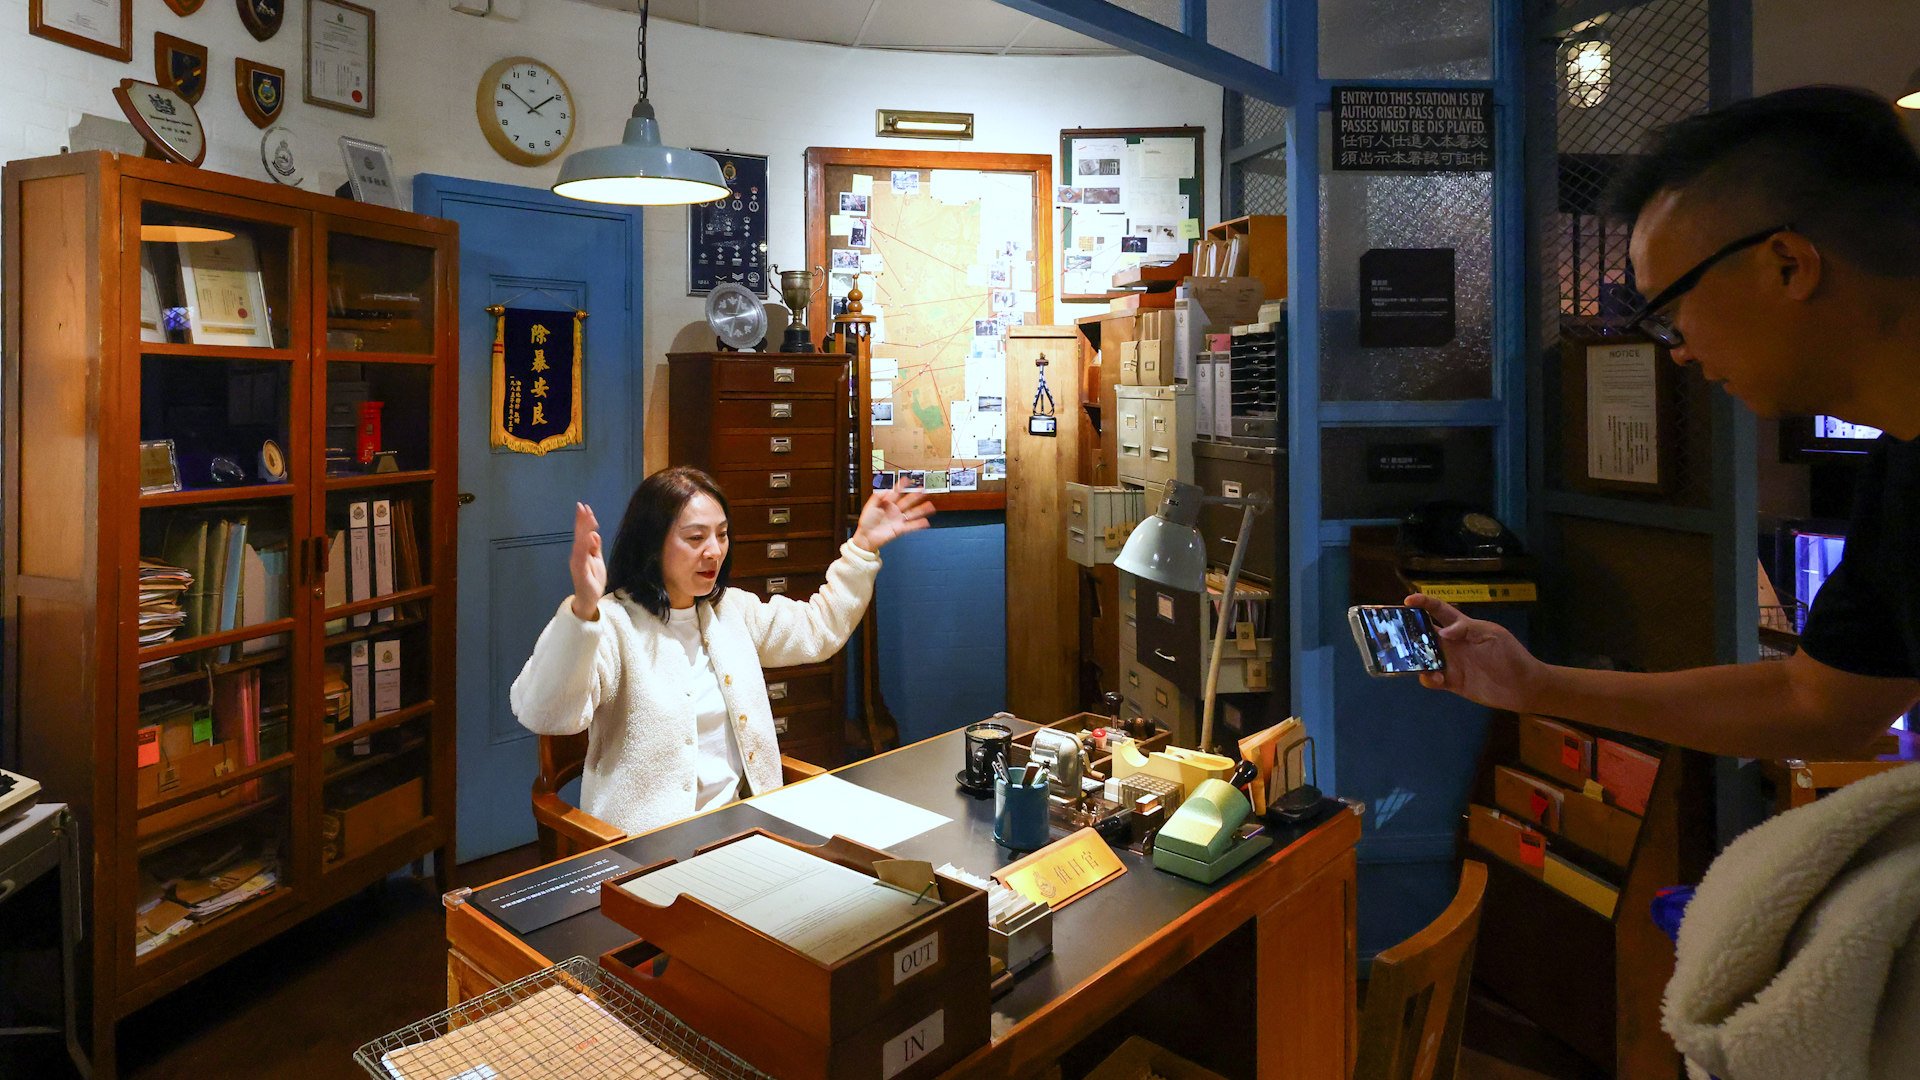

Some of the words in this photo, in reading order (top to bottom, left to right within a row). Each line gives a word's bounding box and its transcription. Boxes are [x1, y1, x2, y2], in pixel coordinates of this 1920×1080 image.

[512, 71, 520, 79] 11
[1341, 91, 1374, 105] ENTRY
[1375, 91, 1388, 105] TO
[1390, 92, 1413, 105] THIS
[1414, 92, 1456, 106] STATION
[1459, 92, 1469, 106] IS
[1471, 92, 1485, 106] BY
[1341, 106, 1407, 119] AUTHORISED
[1408, 106, 1434, 120] PASS
[1341, 119, 1379, 133] PASSES
[1381, 120, 1411, 133] MUST
[1412, 120, 1425, 134] BE
[1609, 349, 1640, 359] NOTICE
[530, 323, 551, 426] 除暴安良
[1456, 588, 1484, 596] KONG
[901, 941, 933, 974] OUT
[903, 1029, 925, 1062] IN
